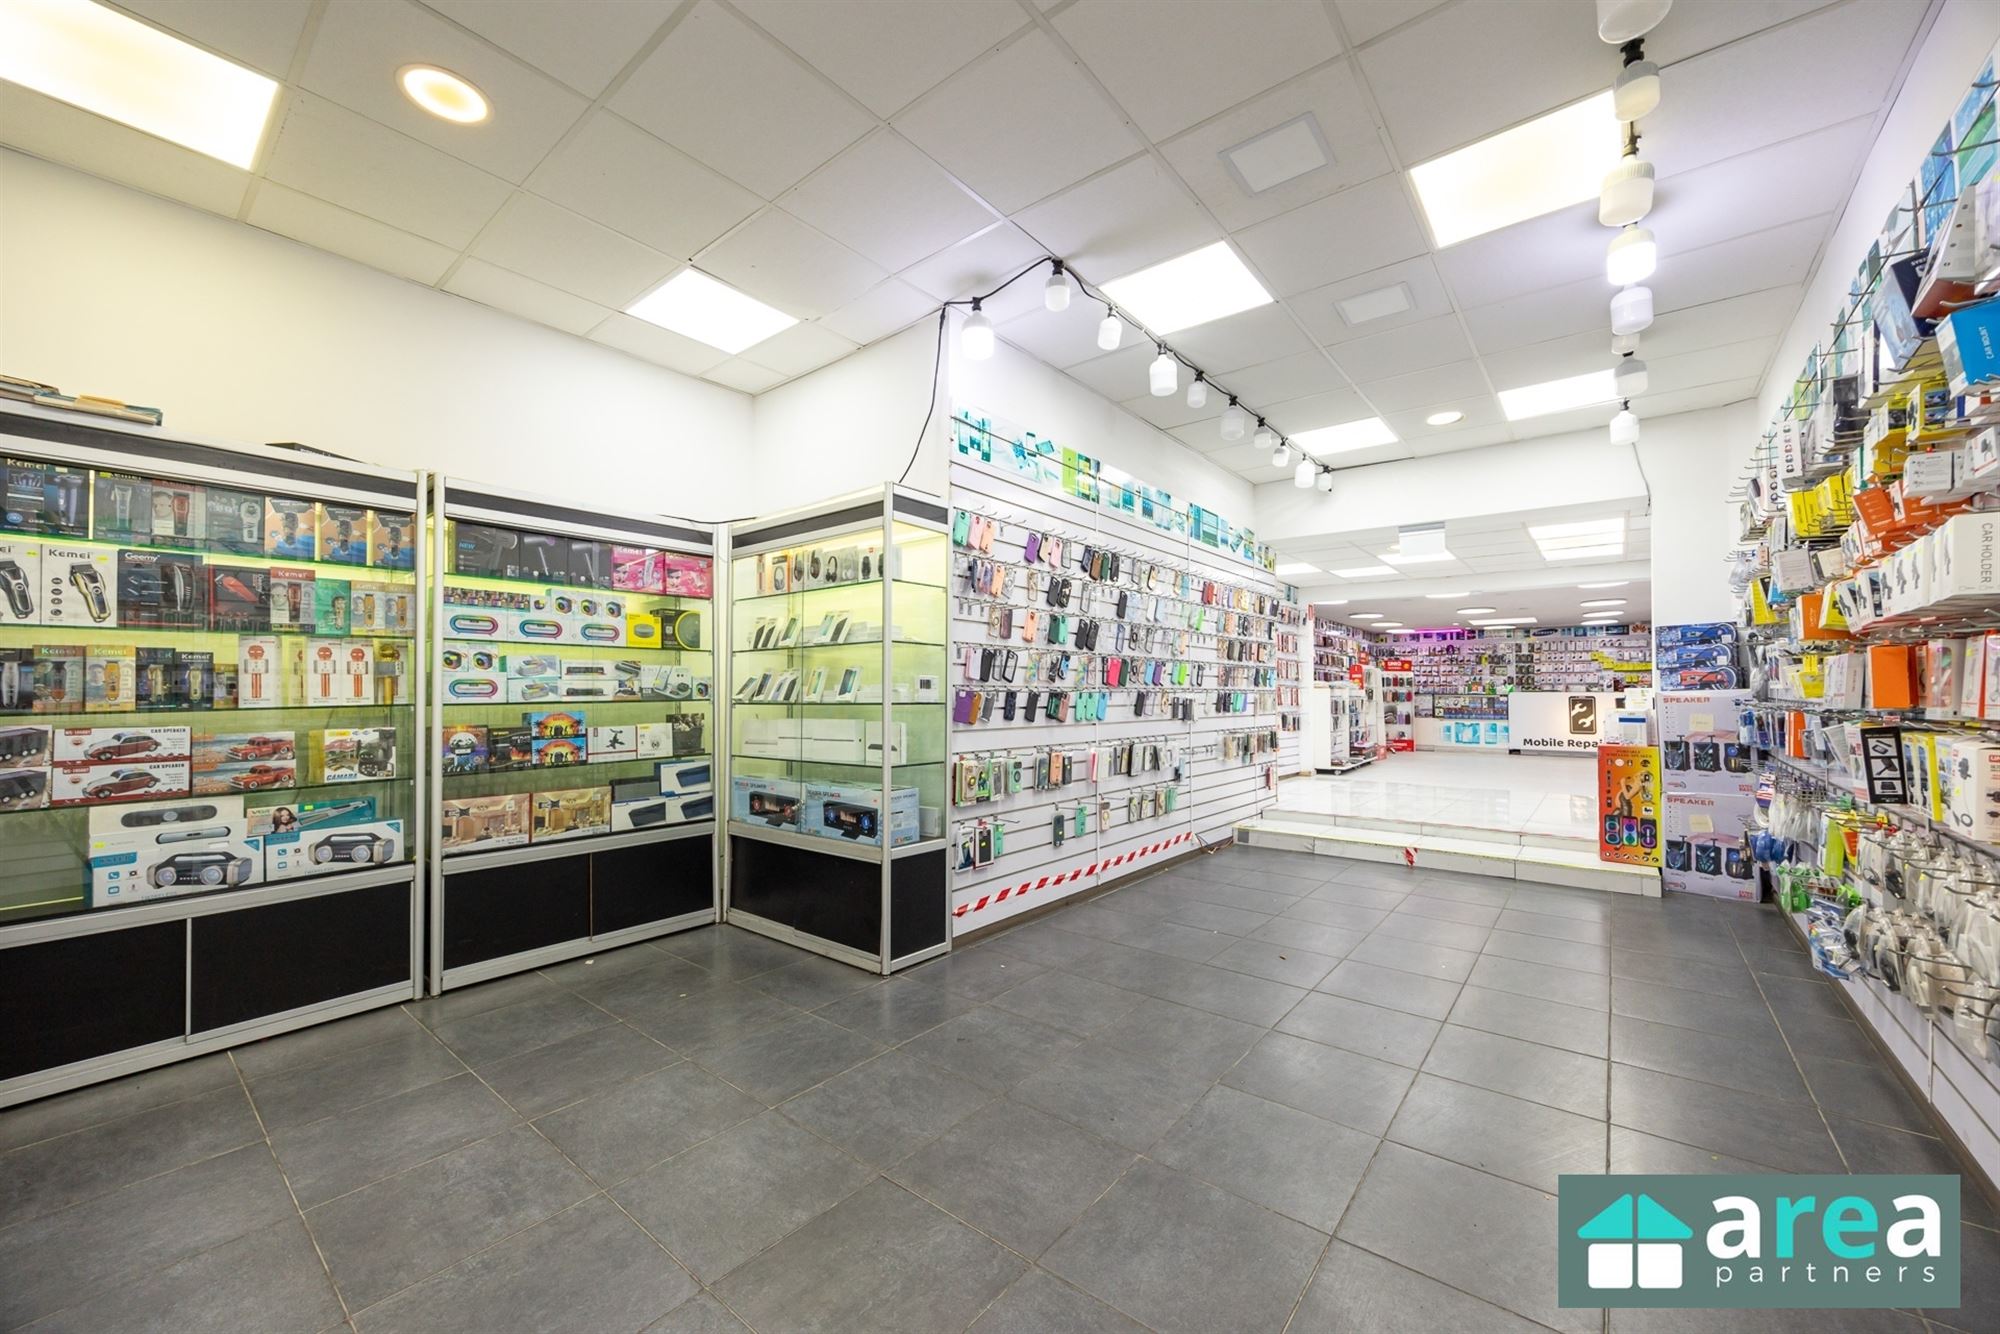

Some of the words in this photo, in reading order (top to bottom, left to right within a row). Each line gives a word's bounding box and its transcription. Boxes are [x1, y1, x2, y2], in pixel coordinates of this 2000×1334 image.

[1982, 523, 1993, 543] CAR
[459, 542, 476, 550] NEW
[49, 549, 91, 559] Kemei
[125, 552, 158, 562] Geemy
[1981, 545, 1993, 583] HOLDER
[278, 570, 308, 578] Kemei
[94, 647, 127, 656] Kemei
[1663, 696, 1710, 704] SPEAKER
[1523, 738, 1564, 747] Mobile
[1667, 797, 1714, 806] SPEAKER
